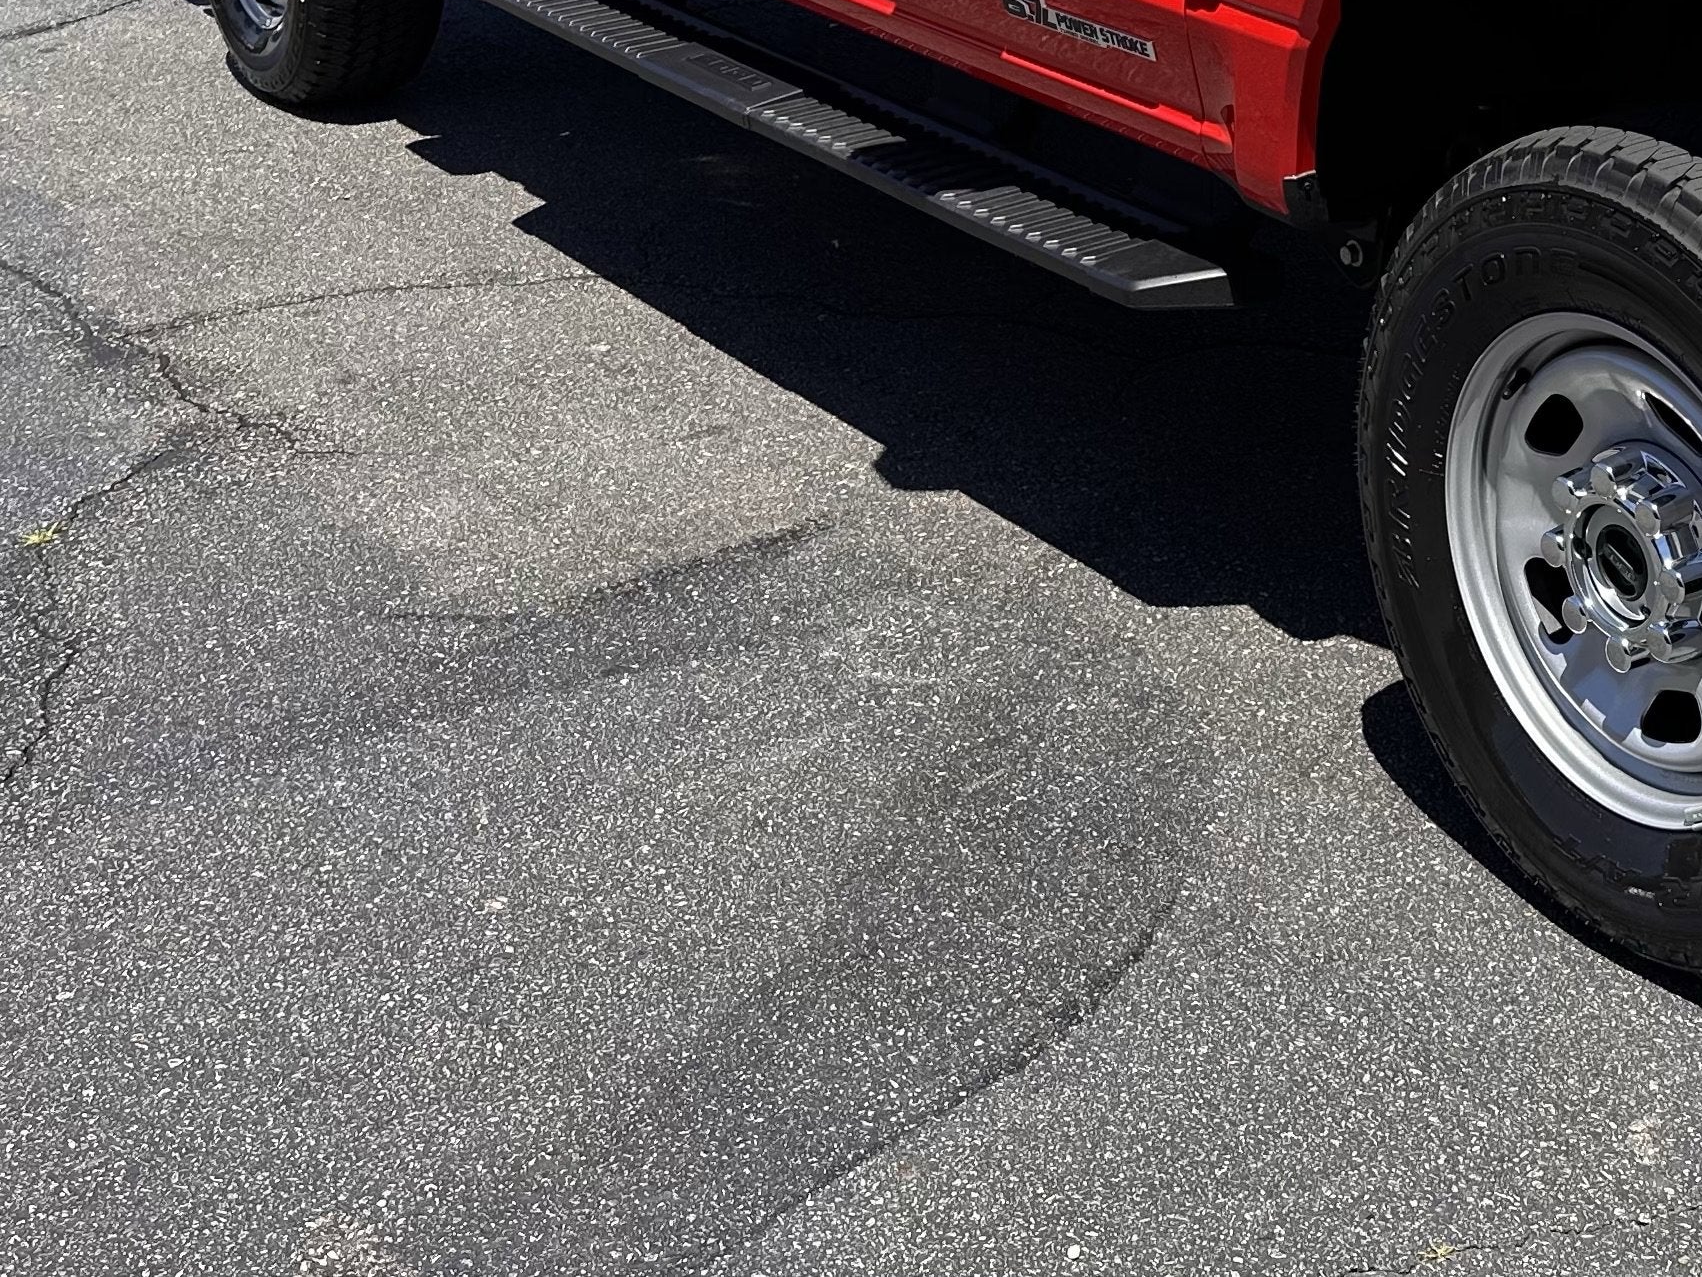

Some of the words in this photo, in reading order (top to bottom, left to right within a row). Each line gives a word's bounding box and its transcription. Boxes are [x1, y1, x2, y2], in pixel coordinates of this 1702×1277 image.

[1055, 12, 1099, 40] POWER
[1100, 27, 1151, 58] STROKE
[1384, 246, 1577, 589] BRIDGESTONE
